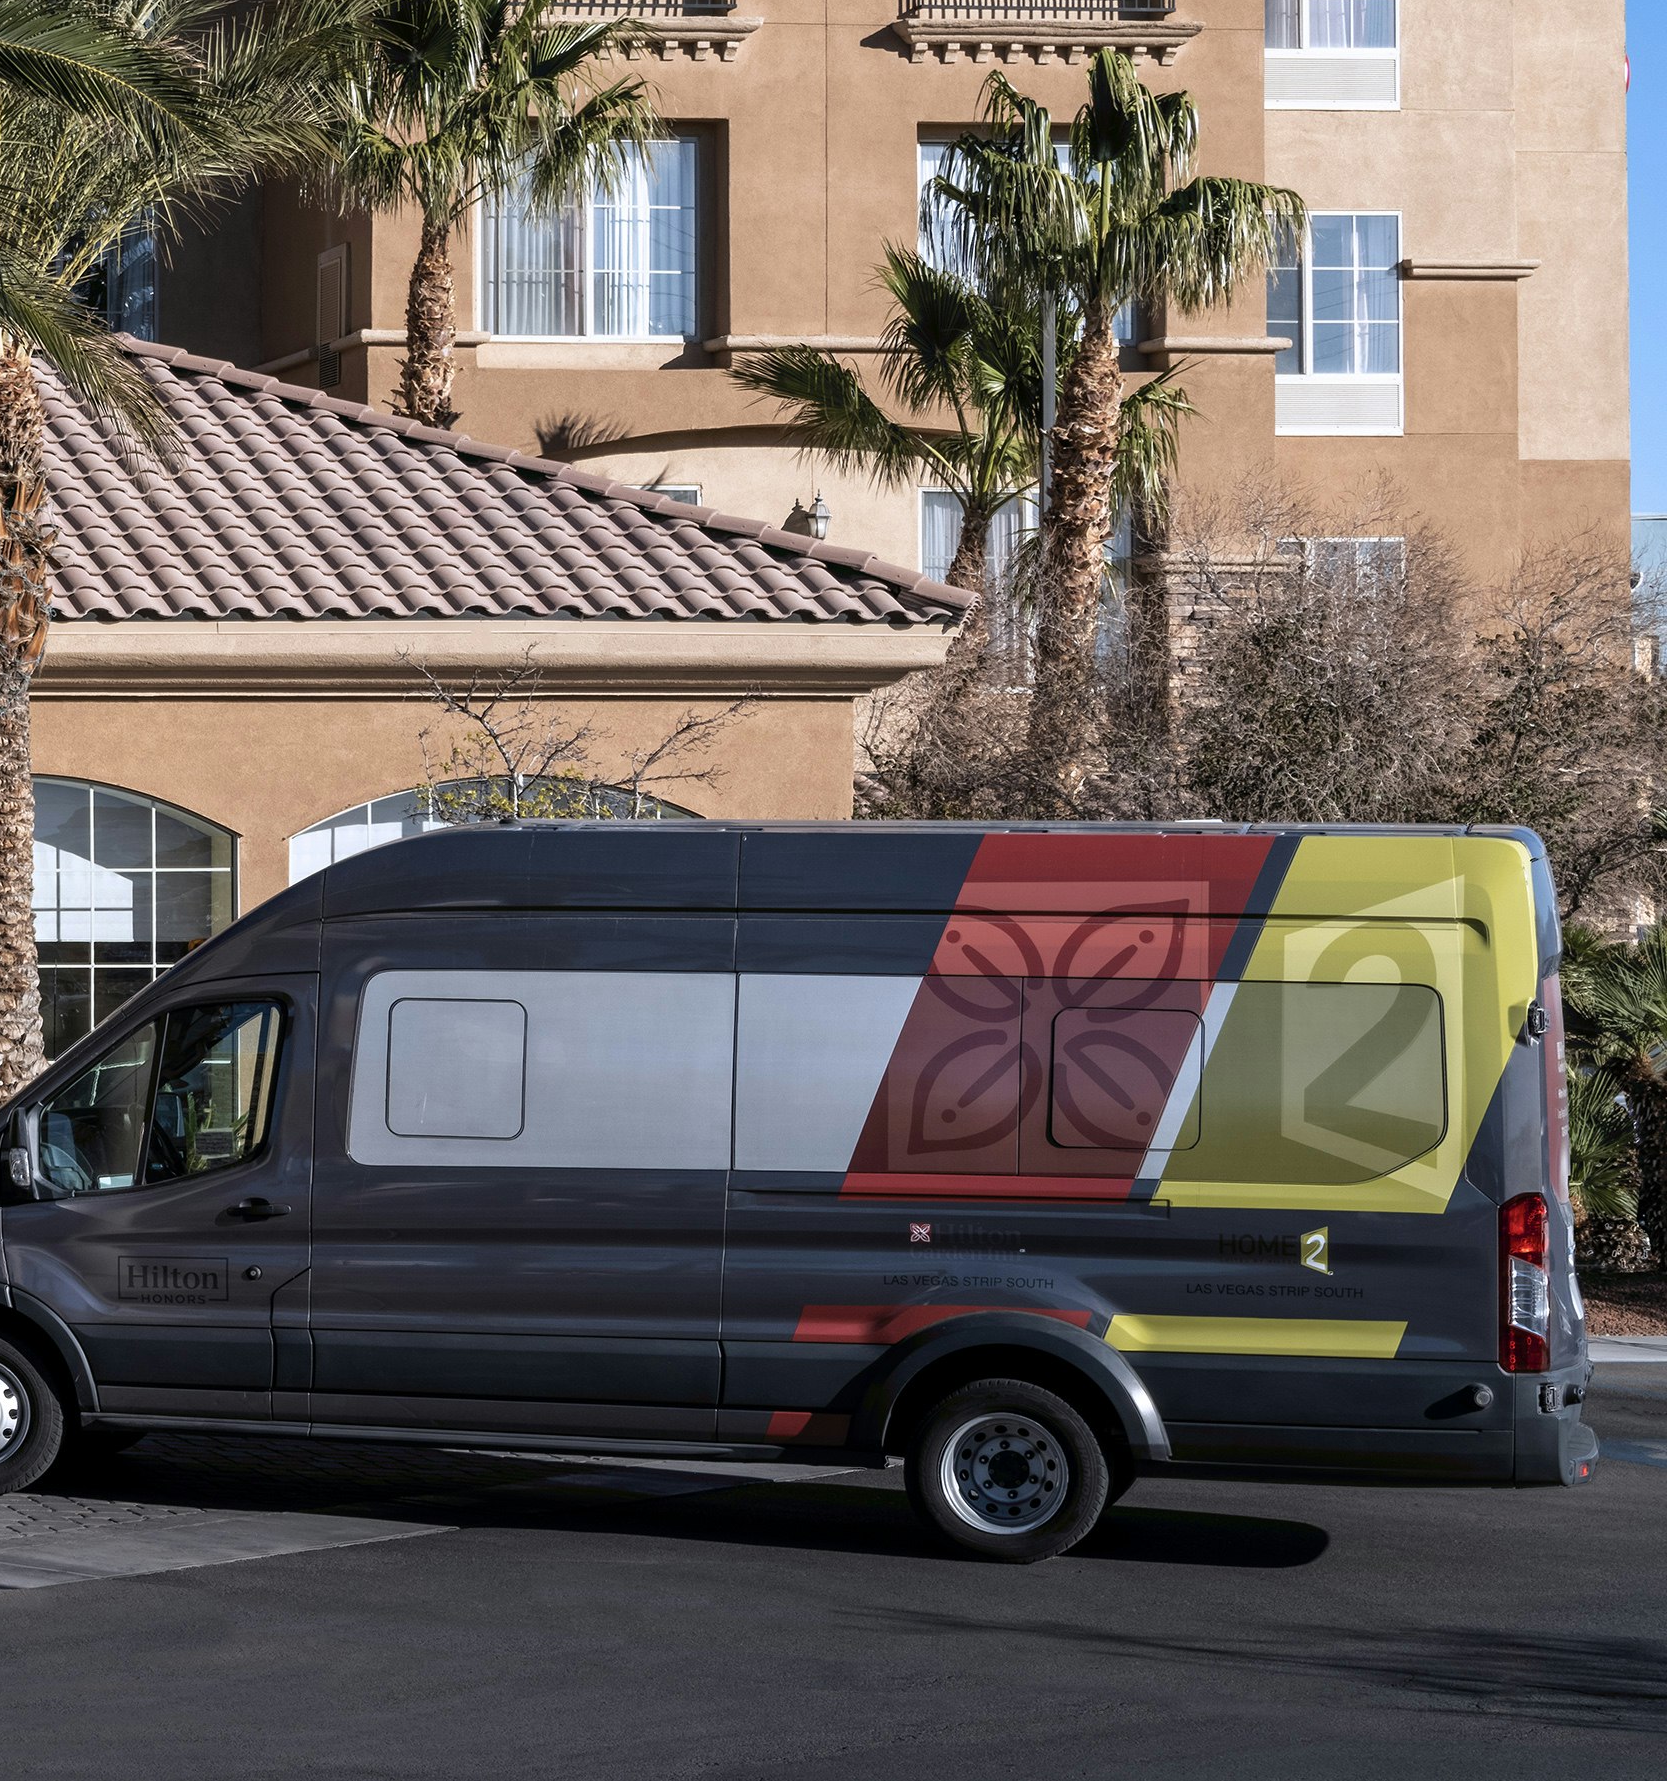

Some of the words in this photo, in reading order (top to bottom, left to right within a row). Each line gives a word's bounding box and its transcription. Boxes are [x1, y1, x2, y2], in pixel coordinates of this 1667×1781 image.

[1303, 920, 1437, 1170] 2
[1219, 1233, 1297, 1257] HOME
[1306, 1234, 1326, 1270] 2
[126, 1264, 219, 1290] Hilton
[883, 1275, 908, 1286] LAS
[913, 1275, 958, 1287] VEGAS
[963, 1276, 1002, 1288] STRIP
[1006, 1277, 1054, 1290] SOUTH
[141, 1293, 206, 1305] HONORS
[1186, 1283, 1212, 1294] LAS
[1217, 1284, 1264, 1296] VEGAS
[1269, 1285, 1310, 1297] STRIP
[1314, 1287, 1364, 1299] SOUTH
